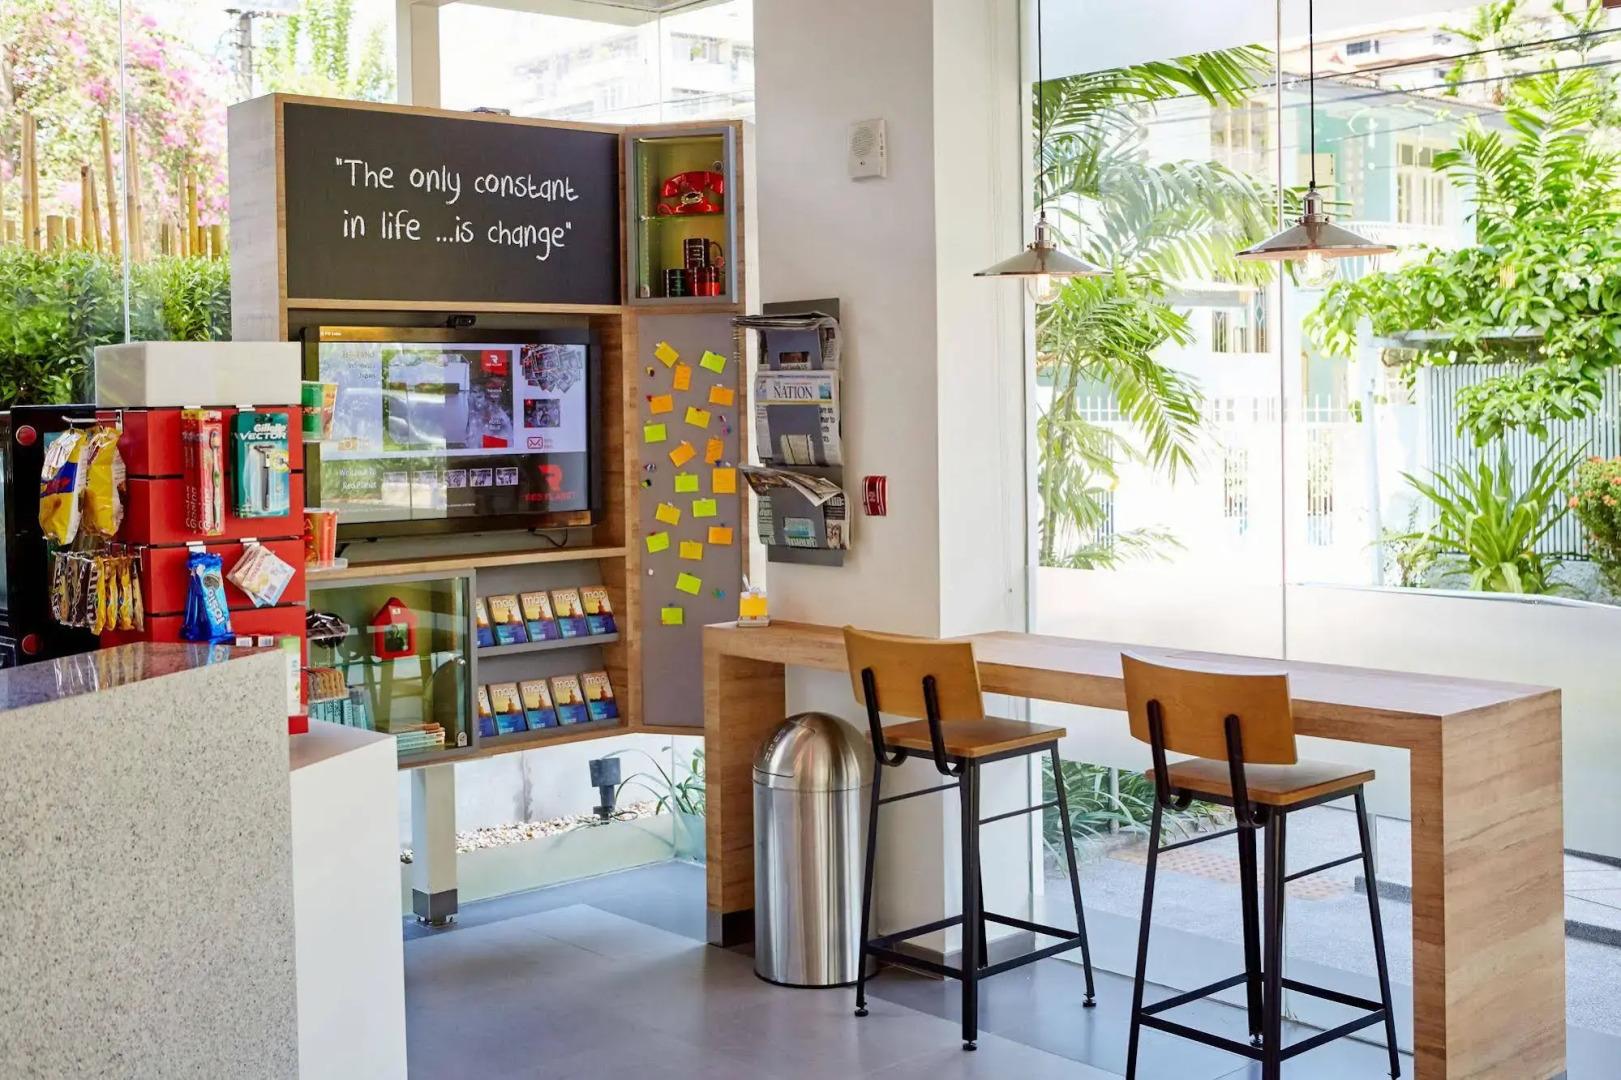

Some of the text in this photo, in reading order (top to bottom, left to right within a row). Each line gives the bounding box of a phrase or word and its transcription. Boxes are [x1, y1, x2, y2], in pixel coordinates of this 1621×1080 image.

[335, 157, 579, 205] "The only constant
[343, 210, 365, 239] in
[381, 209, 421, 241] life
[487, 220, 572, 261] change"
[773, 386, 813, 399] NATION
[253, 422, 286, 432] Gillette
[239, 430, 287, 440] VECTOR
[524, 595, 547, 605] map
[555, 593, 577, 602] map
[583, 590, 606, 600] map
[493, 599, 516, 608] map
[555, 680, 577, 689] map
[585, 675, 608, 685] map
[493, 687, 516, 697] map
[523, 684, 546, 694] map
